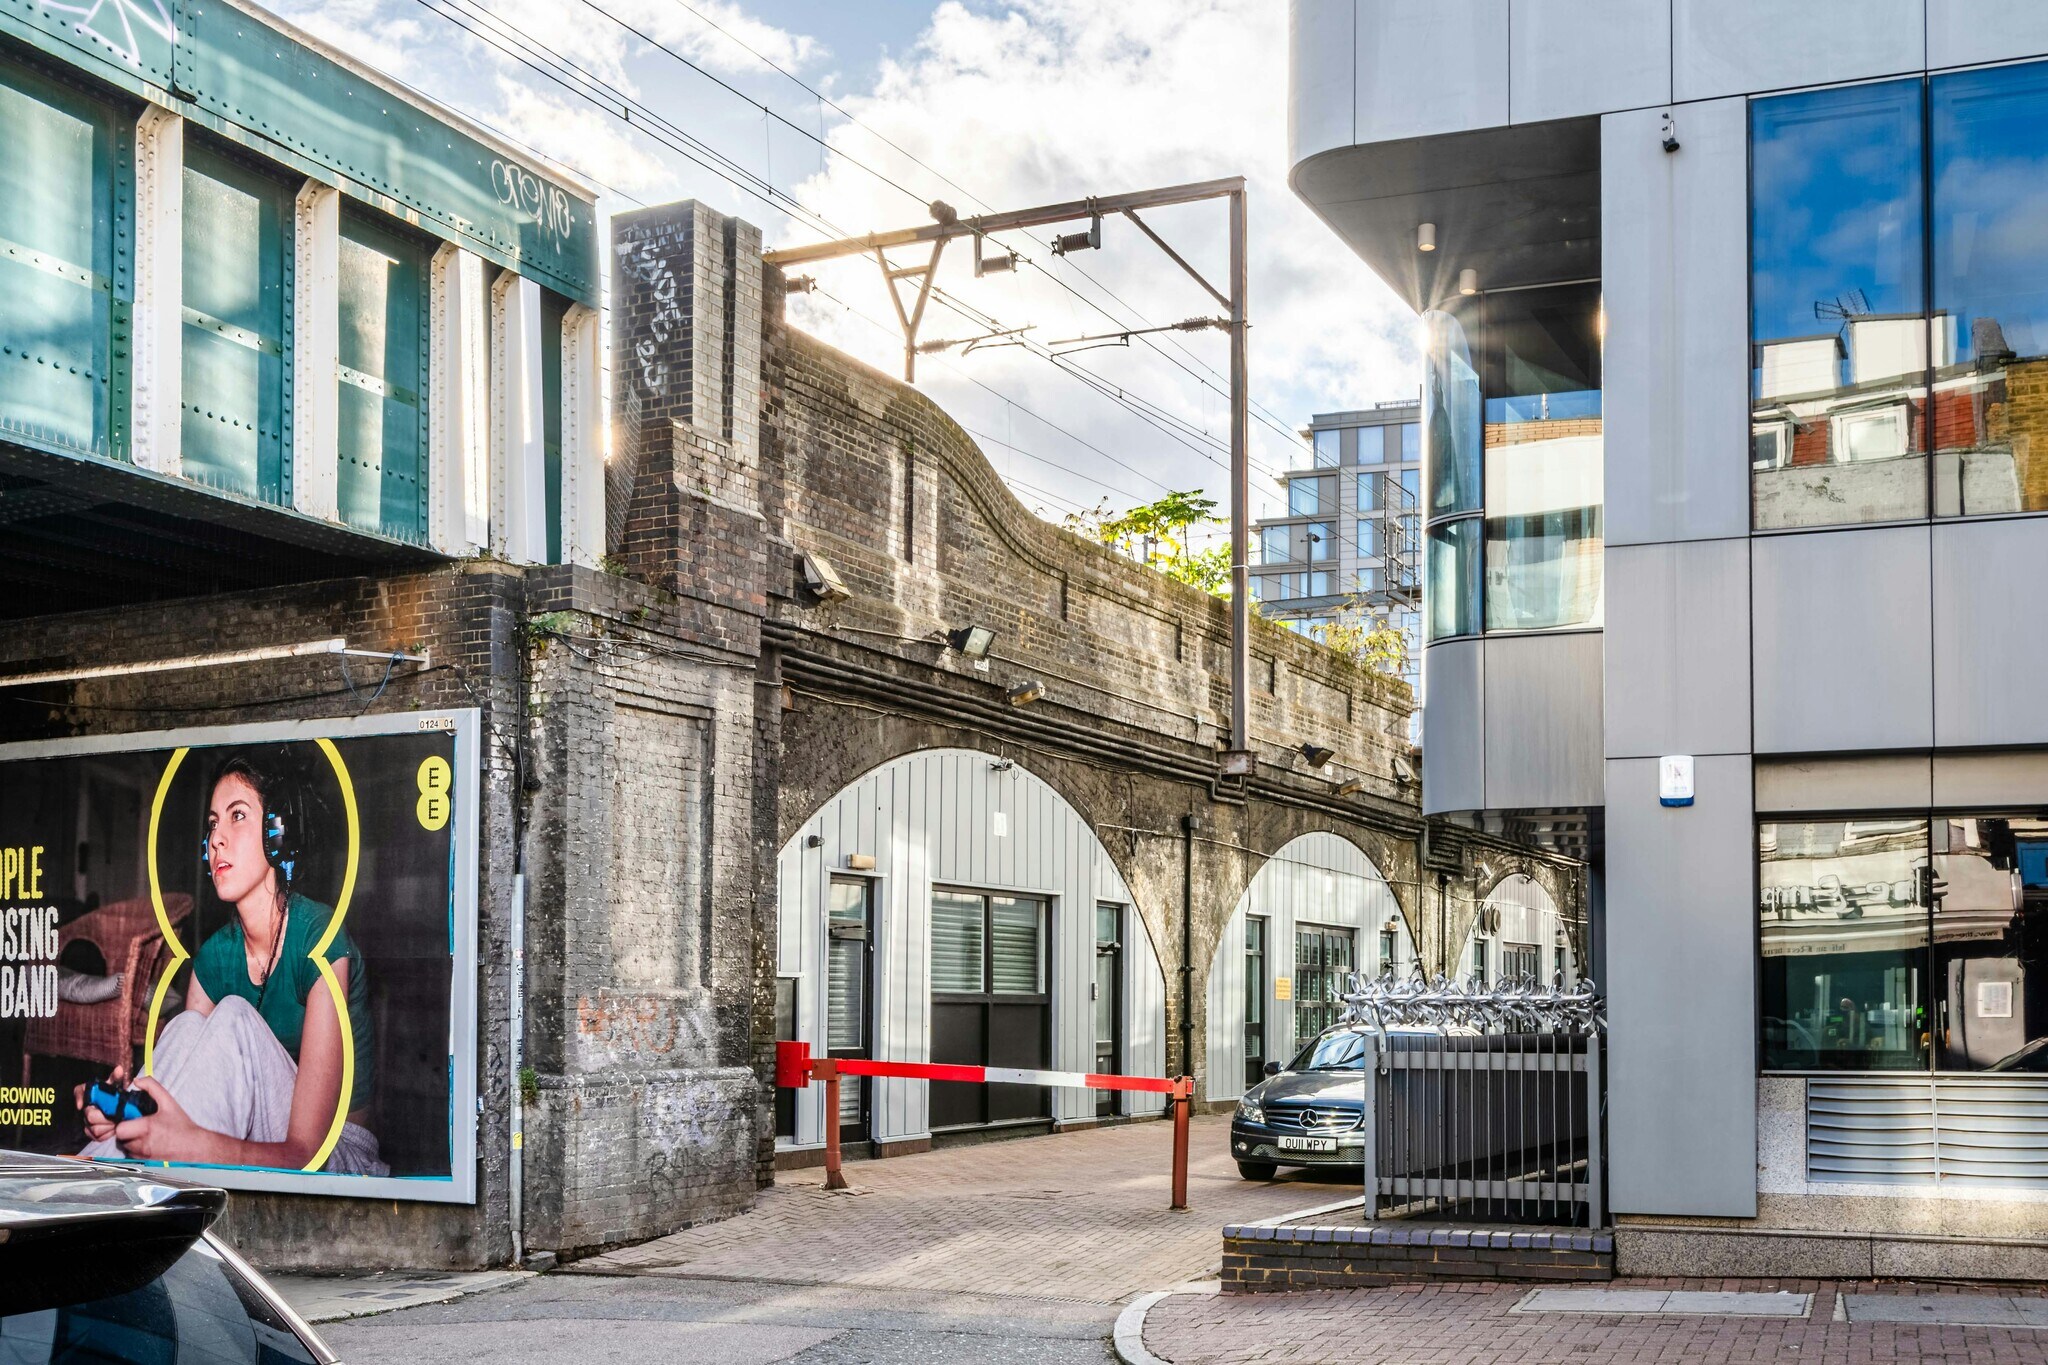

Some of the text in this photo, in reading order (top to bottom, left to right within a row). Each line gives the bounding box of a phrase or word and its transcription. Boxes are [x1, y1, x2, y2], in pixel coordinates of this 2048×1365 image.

[420, 719, 454, 729] 0124 01
[0, 846, 44, 900] PLE
[1, 965, 58, 1018] BAND
[0, 1087, 55, 1104] ROWING
[0, 1109, 51, 1126] OVIDER
[1306, 1139, 1327, 1151] WPY
